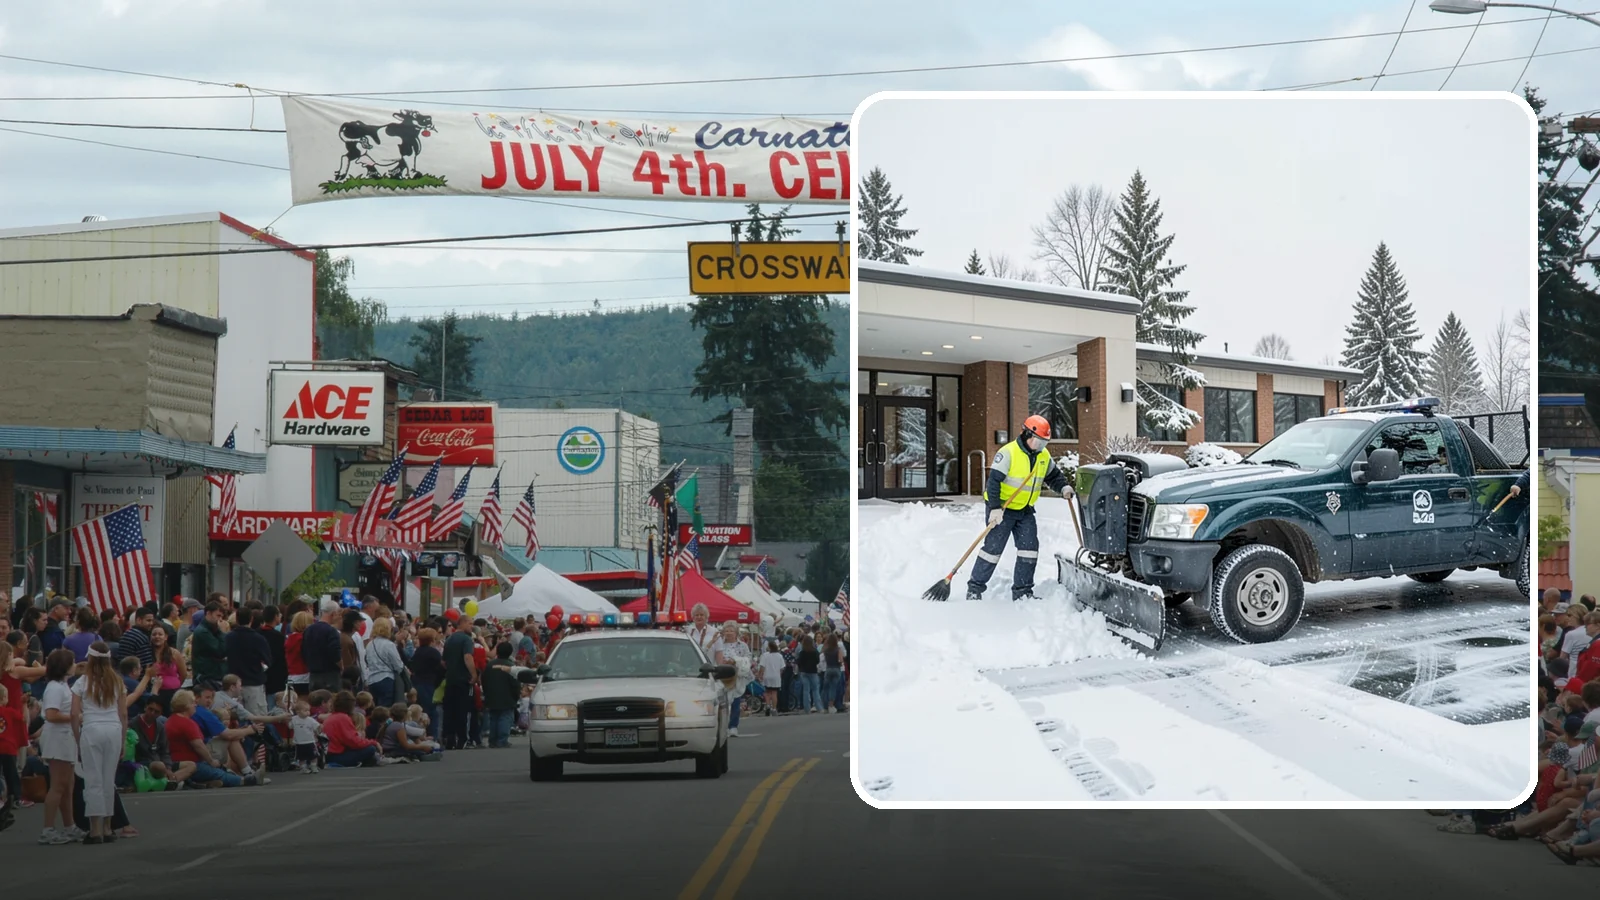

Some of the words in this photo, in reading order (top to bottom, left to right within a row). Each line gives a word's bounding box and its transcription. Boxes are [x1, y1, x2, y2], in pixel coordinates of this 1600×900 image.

[481, 141, 605, 193] JULY
[632, 149, 746, 198] 4th.
[697, 254, 850, 280] CROSSWA
[282, 380, 373, 420] ACE
[405, 409, 453, 422] CEDAR
[460, 409, 485, 422] LOG
[283, 421, 371, 437] Hardware
[354, 467, 385, 480] Simpl
[83, 484, 93, 494] St.
[95, 485, 124, 495] Vincent
[126, 486, 136, 495] de
[137, 486, 155, 495] Paul
[688, 526, 741, 535] CRNATION
[699, 535, 730, 543] GLASS
